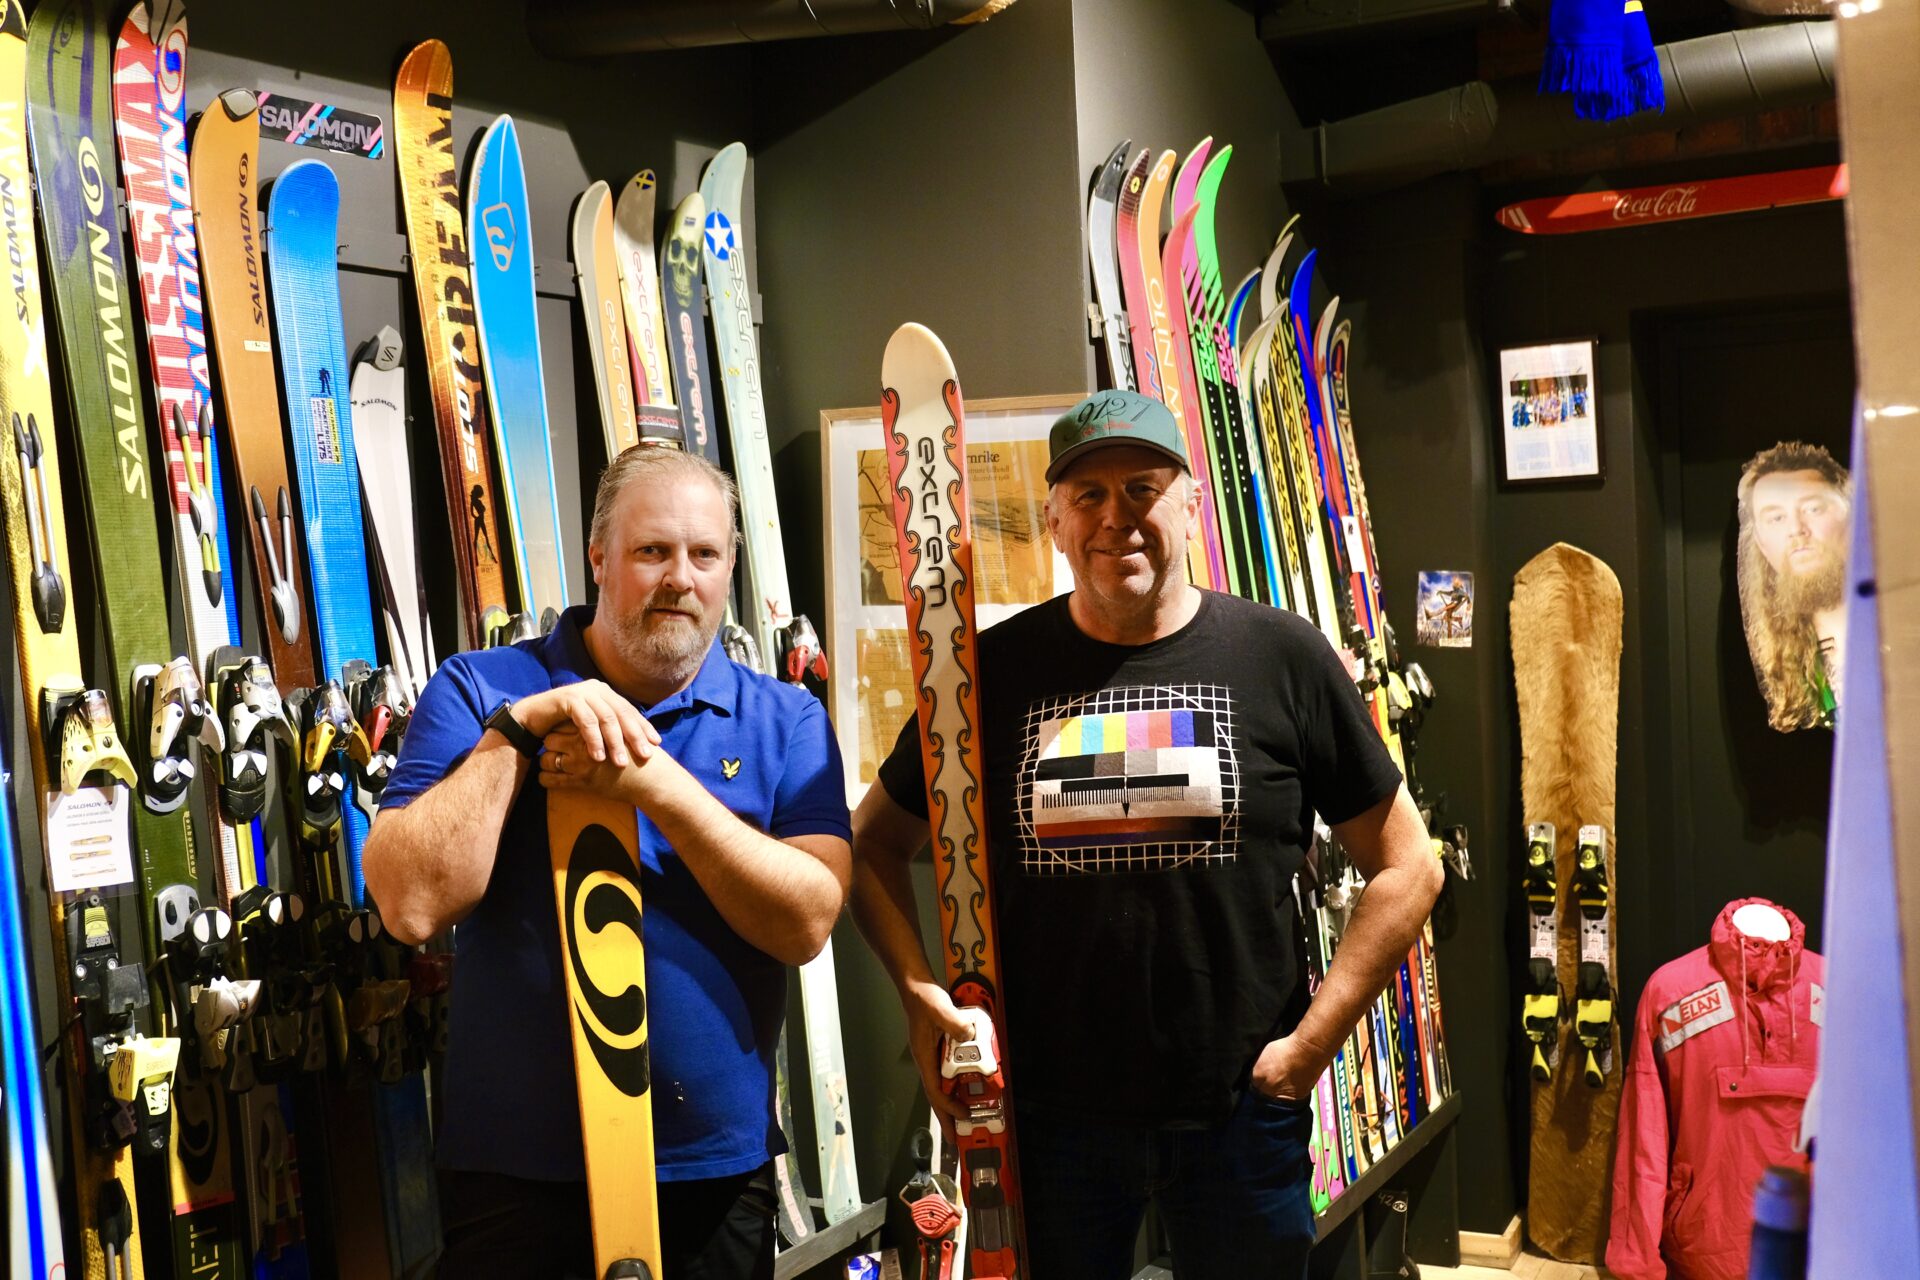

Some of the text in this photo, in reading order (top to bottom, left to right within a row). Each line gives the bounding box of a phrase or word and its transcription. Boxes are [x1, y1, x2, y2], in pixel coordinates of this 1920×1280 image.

[261, 105, 372, 146] SALOMON
[0, 173, 29, 325] SALOMON
[159, 112, 214, 431] SALOMON
[239, 193, 265, 328] SALOMON
[87, 222, 147, 499] SALOMON
[606, 300, 634, 442] extrem
[632, 249, 658, 385] extrem
[680, 311, 708, 446] extrem
[728, 247, 767, 440] extrem
[1150, 277, 1174, 367] OLIN
[360, 398, 397, 411] SALOMON
[450, 342, 479, 473] SCOTT
[917, 436, 947, 608] extrem
[67, 801, 101, 811] SALOMON
[1681, 993, 1721, 1020] ELAN
